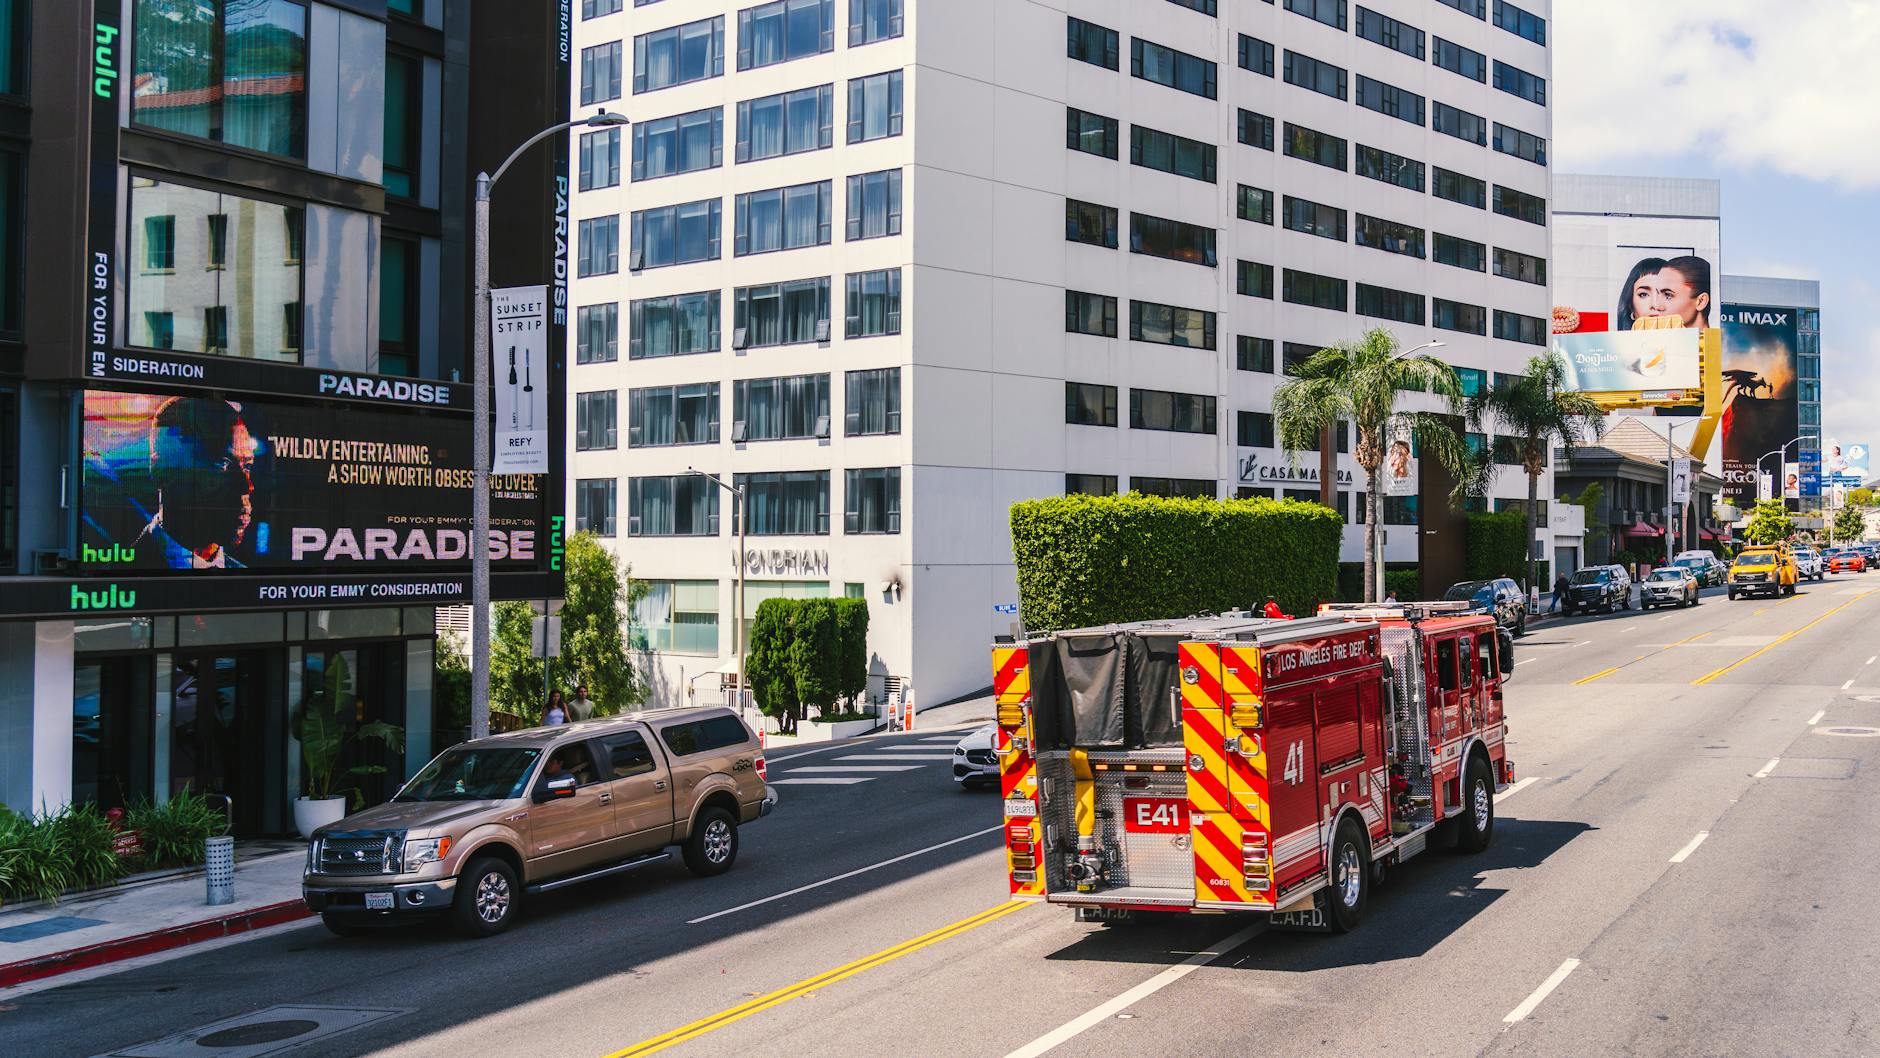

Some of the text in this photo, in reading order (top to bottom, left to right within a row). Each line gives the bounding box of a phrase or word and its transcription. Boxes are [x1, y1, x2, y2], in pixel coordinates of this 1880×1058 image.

[95, 24, 119, 98] hulu
[554, 175, 568, 327] PARADISE
[92, 252, 108, 377] FOR YOUR EM
[497, 302, 542, 314] SUNSET
[1720, 311, 1787, 326] OR IMAX
[498, 320, 542, 333] STRIP
[113, 357, 204, 379] SIDERATION
[319, 374, 450, 404] PARADISE
[332, 440, 432, 466] ENTERTAINING.
[509, 438, 532, 448] REFY
[328, 464, 338, 483] A
[340, 464, 382, 486] SHOW
[385, 465, 432, 487] WORTH
[435, 468, 502, 490] OBSESNG
[1260, 466, 1353, 482] CASA MARA
[387, 515, 407, 524] FOR
[409, 516, 435, 525] YOUR
[468, 518, 536, 526] CSIDERATION
[83, 543, 135, 562] hulu
[551, 515, 564, 571] hulu
[71, 583, 136, 609] hulu
[259, 586, 287, 599] FOR
[291, 585, 326, 598] YOUR
[370, 582, 463, 596] CONSIDERATION
[1281, 640, 1368, 671] LOS ANGELES FIRE DEPT.
[1283, 739, 1304, 786] 41
[1136, 803, 1179, 827] E41
[1209, 878, 1230, 887] 60831
